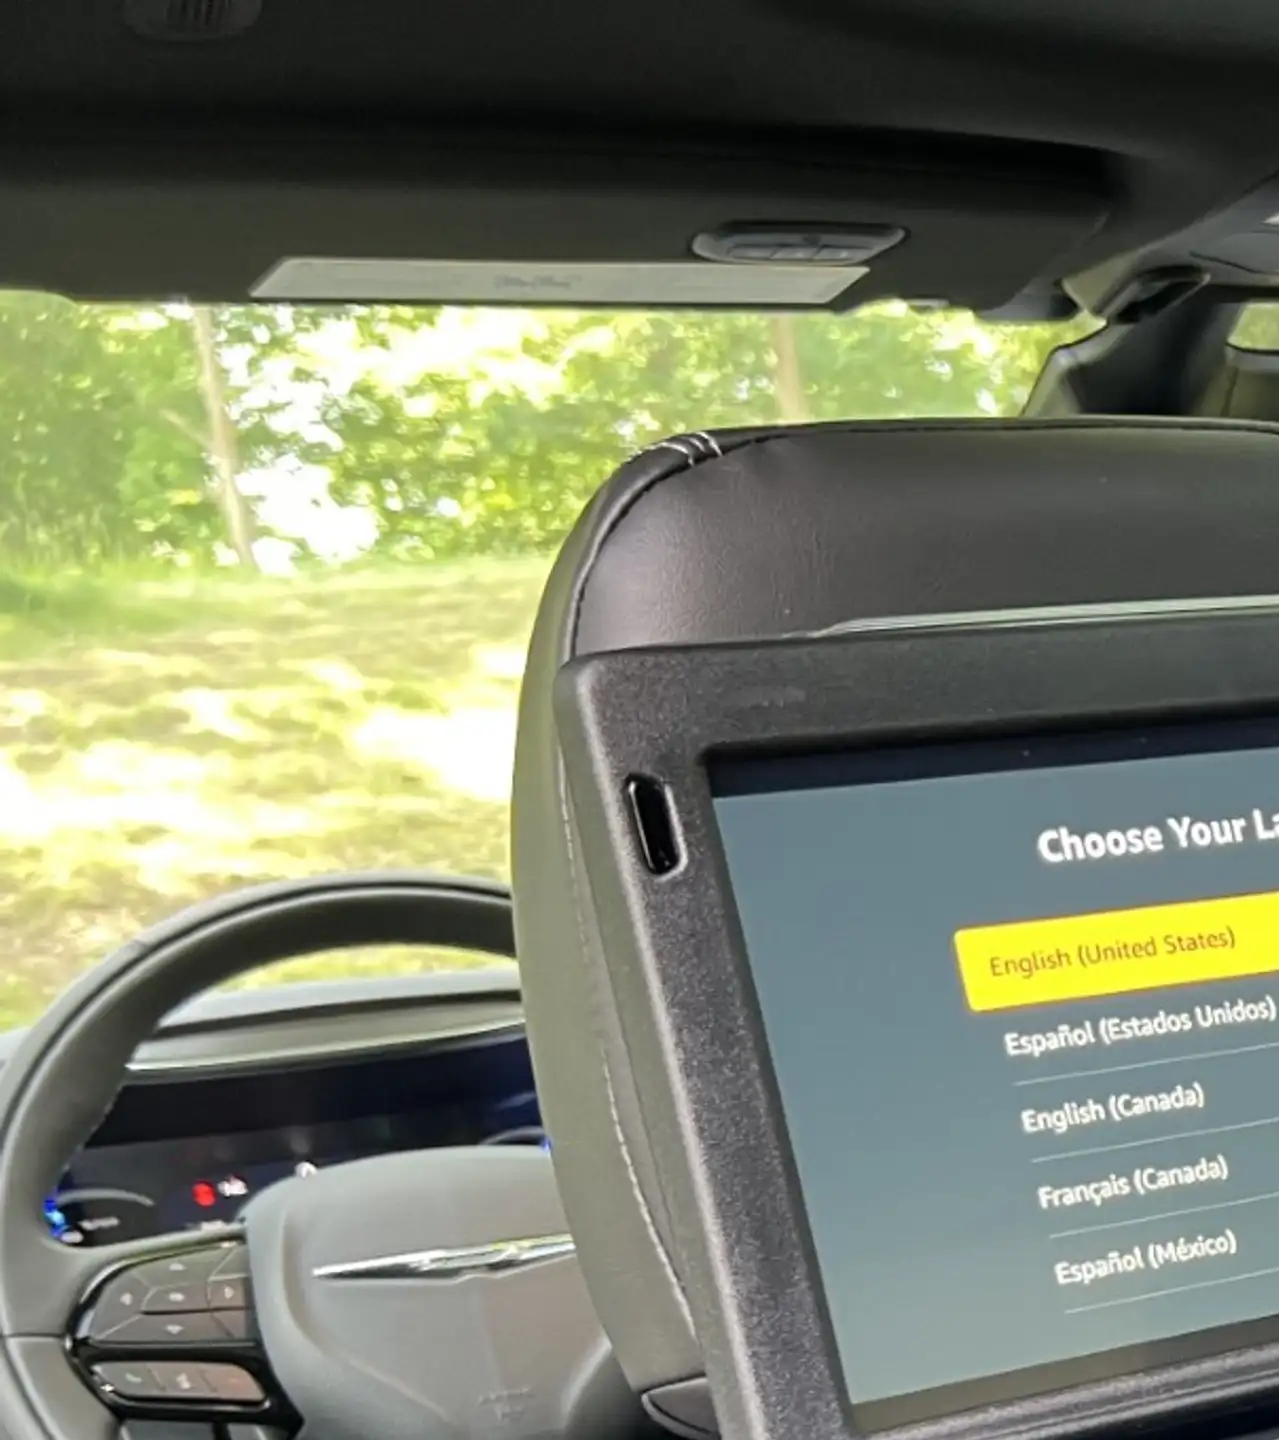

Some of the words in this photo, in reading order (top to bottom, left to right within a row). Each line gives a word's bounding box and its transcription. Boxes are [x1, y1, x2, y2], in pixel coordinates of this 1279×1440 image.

[1037, 822, 1164, 863] Choose
[1167, 814, 1248, 849] Your
[990, 949, 1072, 980] English
[1077, 938, 1158, 969] (United
[1164, 926, 1237, 955] States)
[1003, 1020, 1096, 1058] Español
[1098, 1010, 1192, 1046] (Estados
[1195, 994, 1278, 1028] Unidos)
[1020, 1098, 1106, 1135] English
[1108, 1081, 1206, 1122] (Canada)
[1037, 1173, 1131, 1210] Français
[1132, 1154, 1230, 1196] (Canada)
[1053, 1245, 1145, 1286] Español
[1147, 1228, 1238, 1270] (México)
